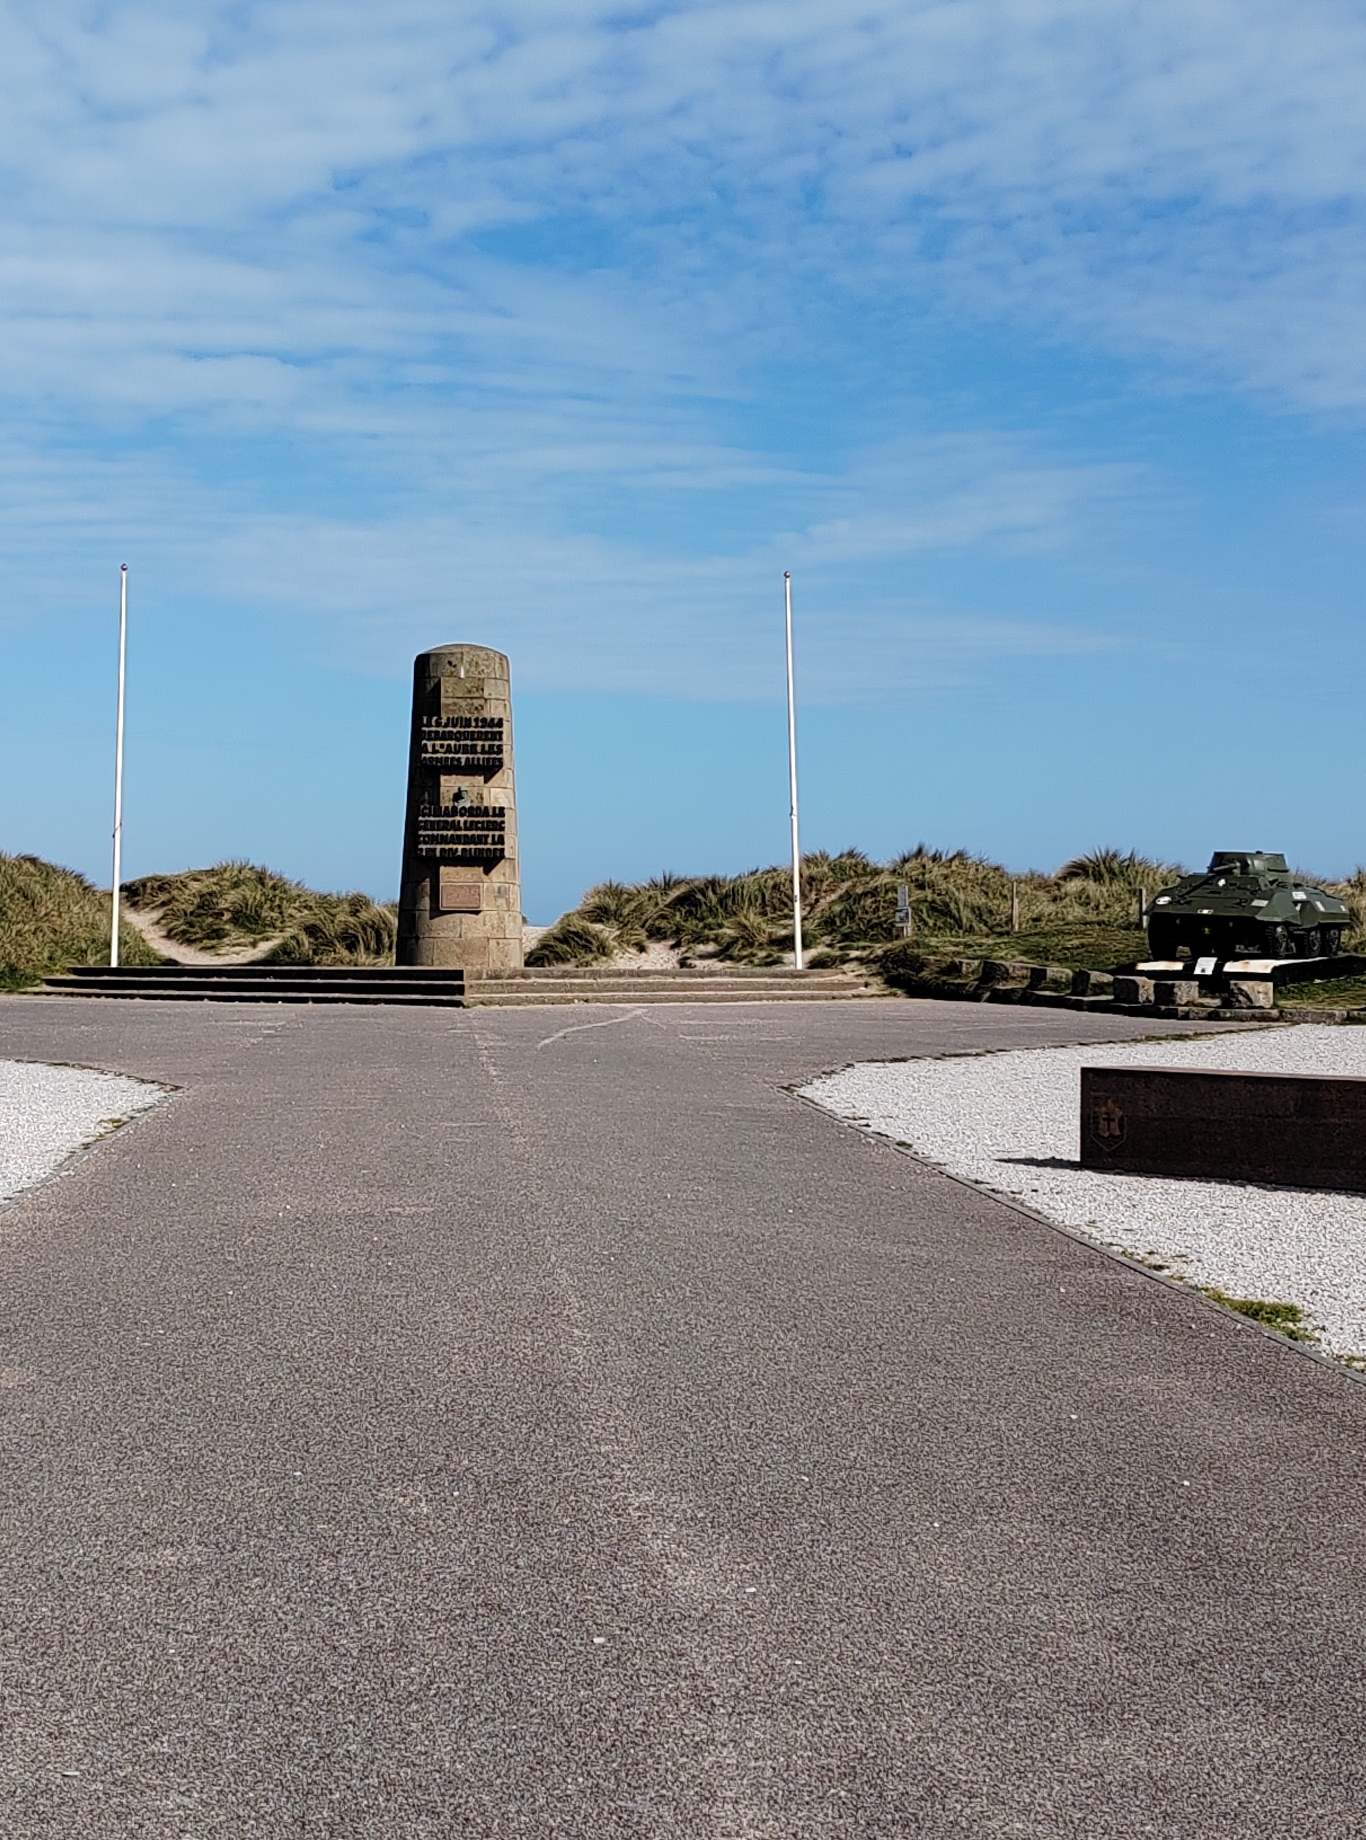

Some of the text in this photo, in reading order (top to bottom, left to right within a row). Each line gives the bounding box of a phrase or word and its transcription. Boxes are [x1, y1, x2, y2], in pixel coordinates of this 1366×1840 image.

[444, 716, 472, 728] JUIN
[473, 716, 504, 728] 1944
[480, 743, 504, 755] LES
[492, 806, 506, 818] LE
[463, 820, 506, 832] LECLERC
[492, 834, 505, 846] LA
